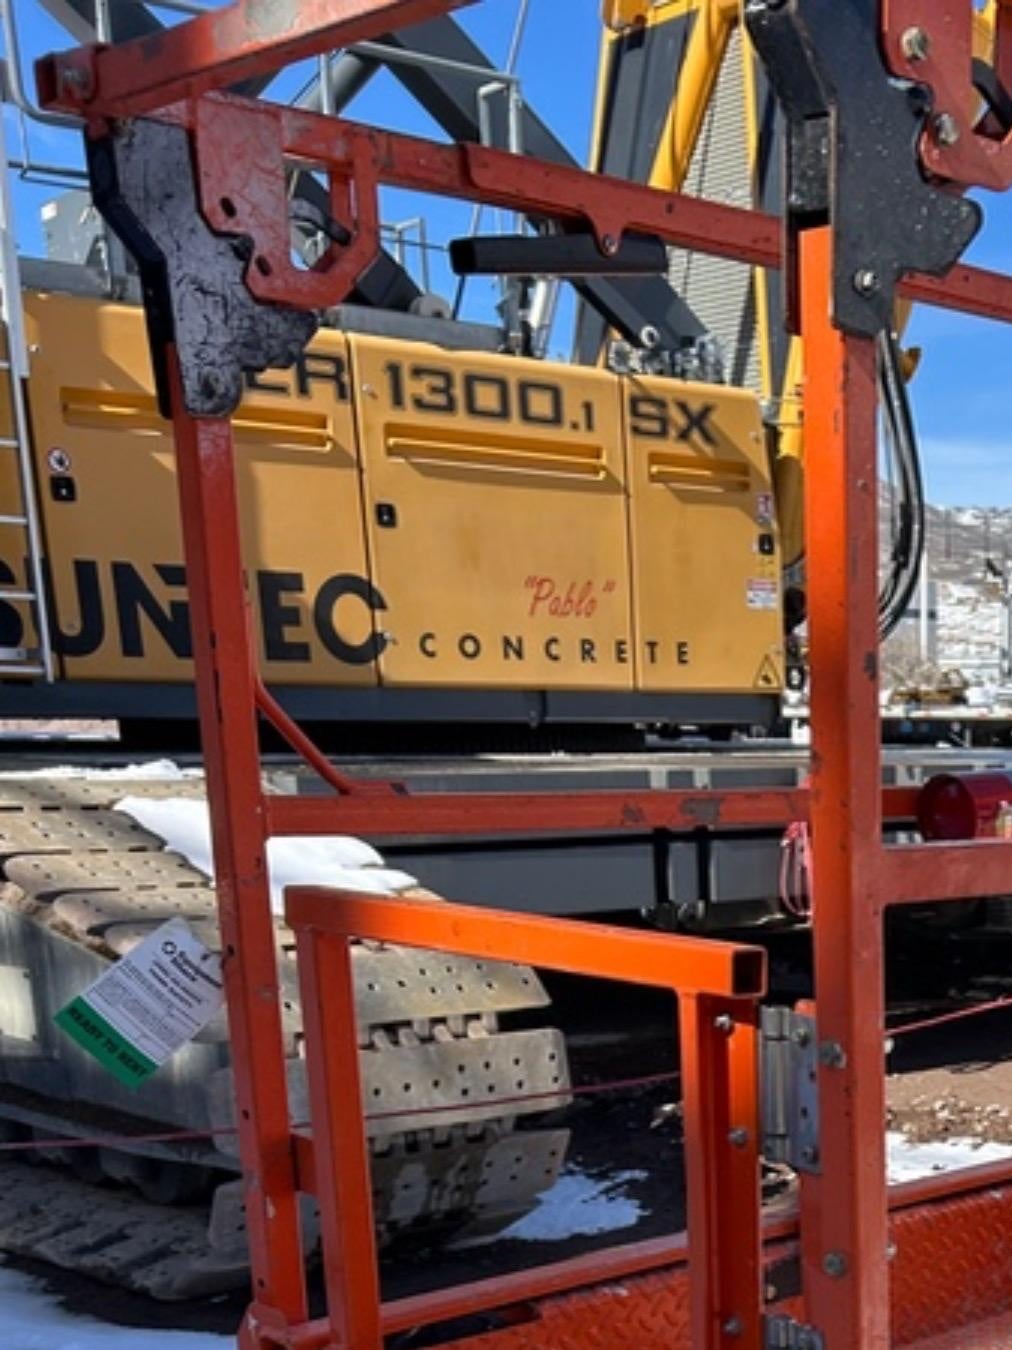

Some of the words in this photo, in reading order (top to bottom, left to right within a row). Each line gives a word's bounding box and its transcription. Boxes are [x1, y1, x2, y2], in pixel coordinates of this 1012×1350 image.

[385, 361, 595, 433] 1300.1
[628, 396, 719, 447] SX
[0, 556, 389, 665] UNEC
[419, 632, 690, 665] CONCRETE
